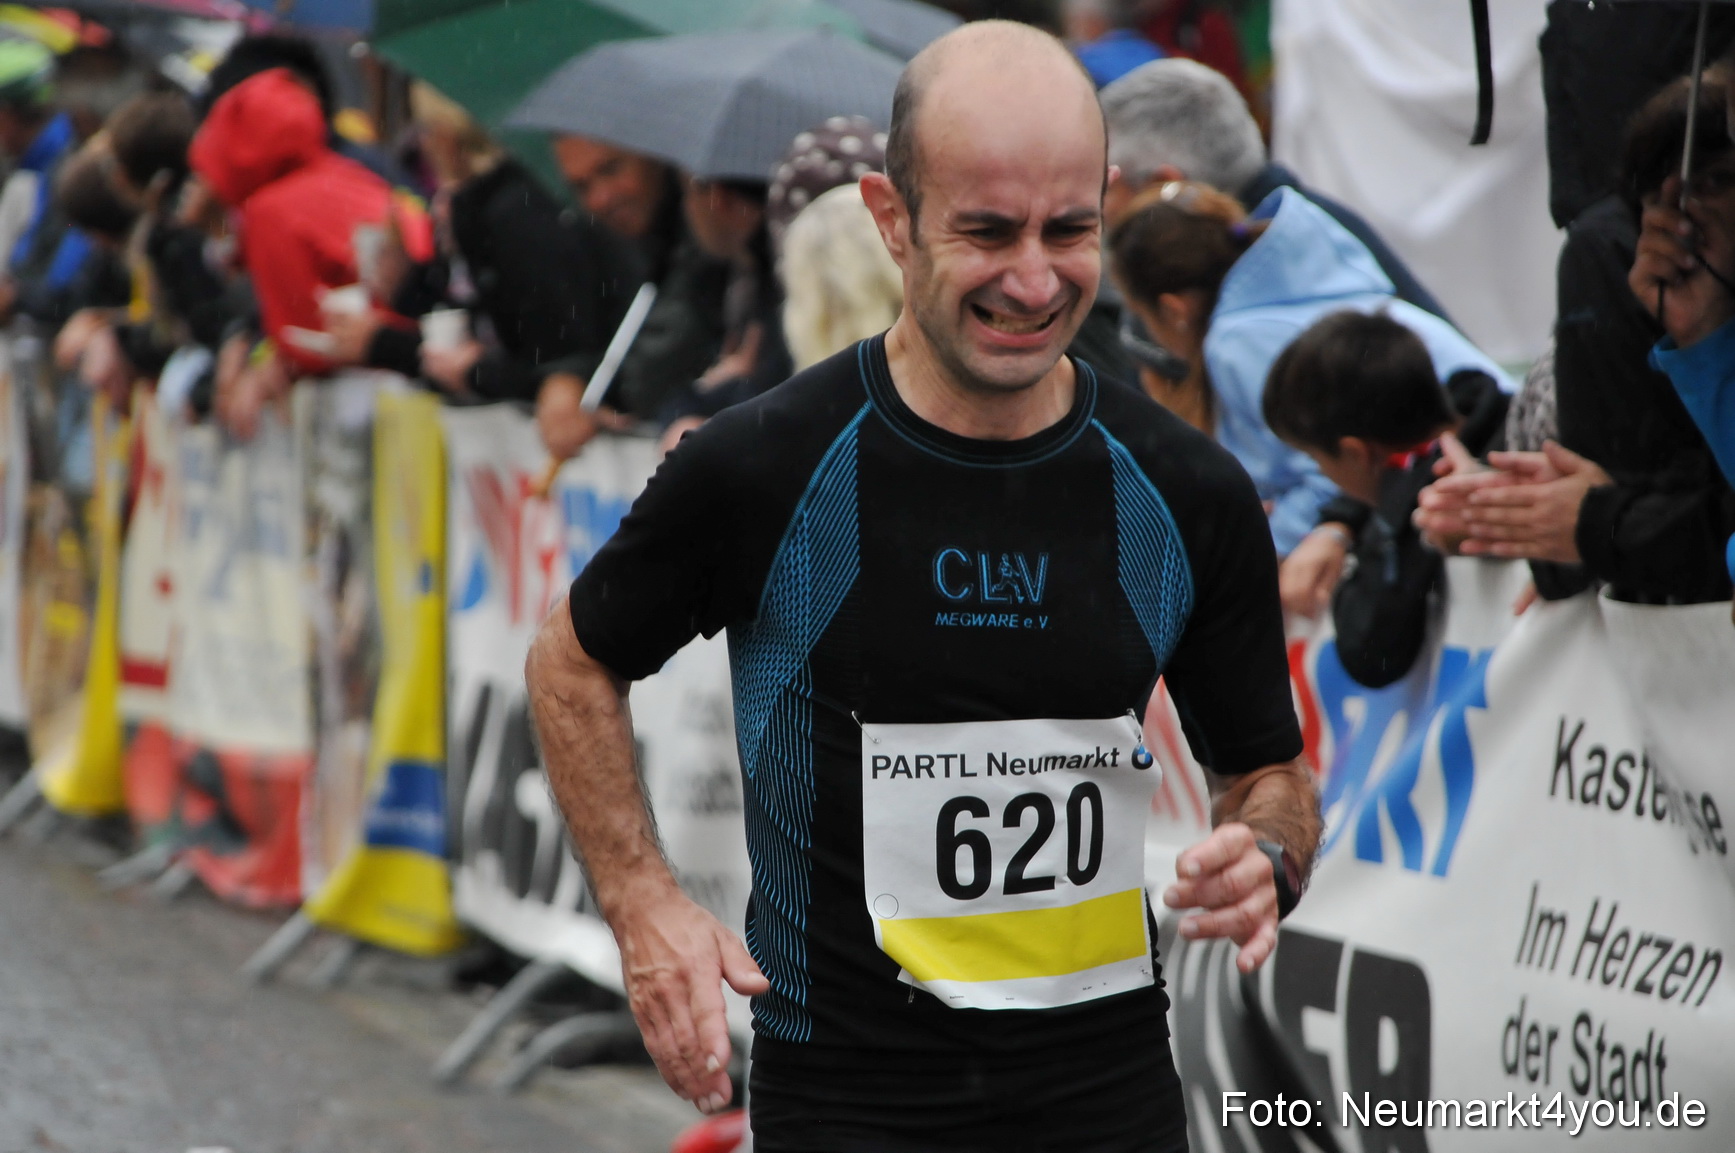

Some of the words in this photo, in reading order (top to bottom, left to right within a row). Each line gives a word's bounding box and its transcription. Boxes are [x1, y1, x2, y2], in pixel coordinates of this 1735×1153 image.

[935, 612, 1019, 628] MEGWARE
[871, 753, 978, 780] PARTL
[986, 746, 1120, 777] Neumarkt
[936, 781, 1104, 900] 620
[1516, 882, 1568, 970] Im
[1571, 897, 1723, 1007] Herzen
[1502, 995, 1558, 1086] der
[1570, 1012, 1670, 1118] Stadt
